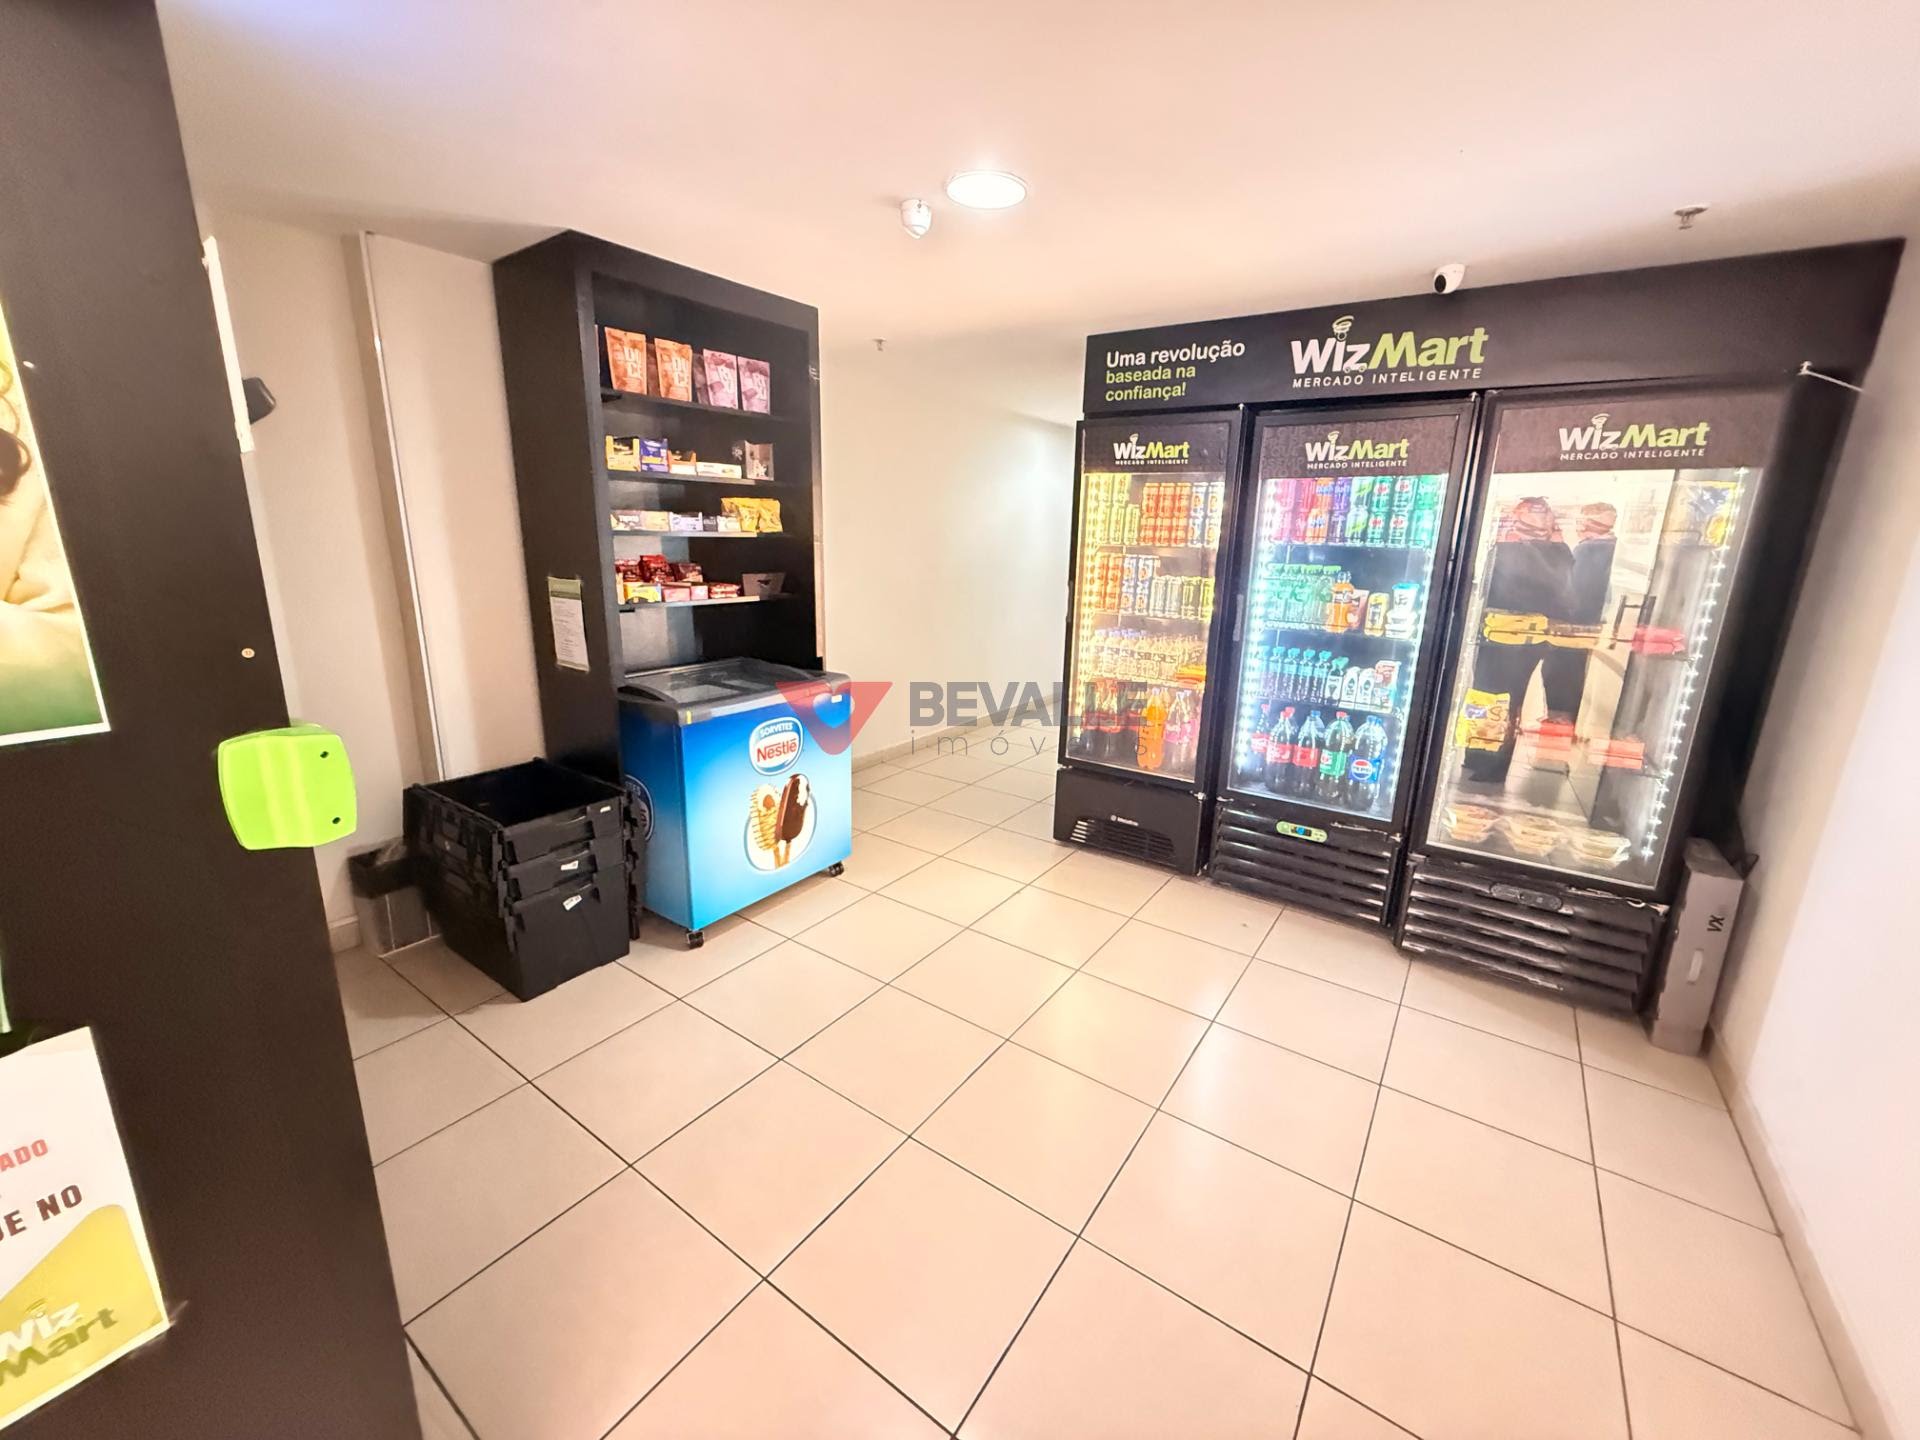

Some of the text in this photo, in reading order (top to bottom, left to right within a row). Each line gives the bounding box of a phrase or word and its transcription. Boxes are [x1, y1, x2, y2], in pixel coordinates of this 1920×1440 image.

[1106, 339, 1245, 368] Uma revolução
[1290, 327, 1489, 374] WizMart
[1106, 366, 1196, 384] baseada na
[1292, 368, 1482, 389] MERCADO INTELIGENTE
[1105, 382, 1186, 401] confiança!
[1559, 422, 1711, 451] WizMart
[1113, 441, 1190, 460] WizMart
[1305, 438, 1410, 462] WizMart
[1560, 448, 1705, 461] MERCADO INTELIGENTE
[1307, 459, 1407, 470] MERCADO INTELIGENTE
[0, 1185, 82, 1242] E NO
